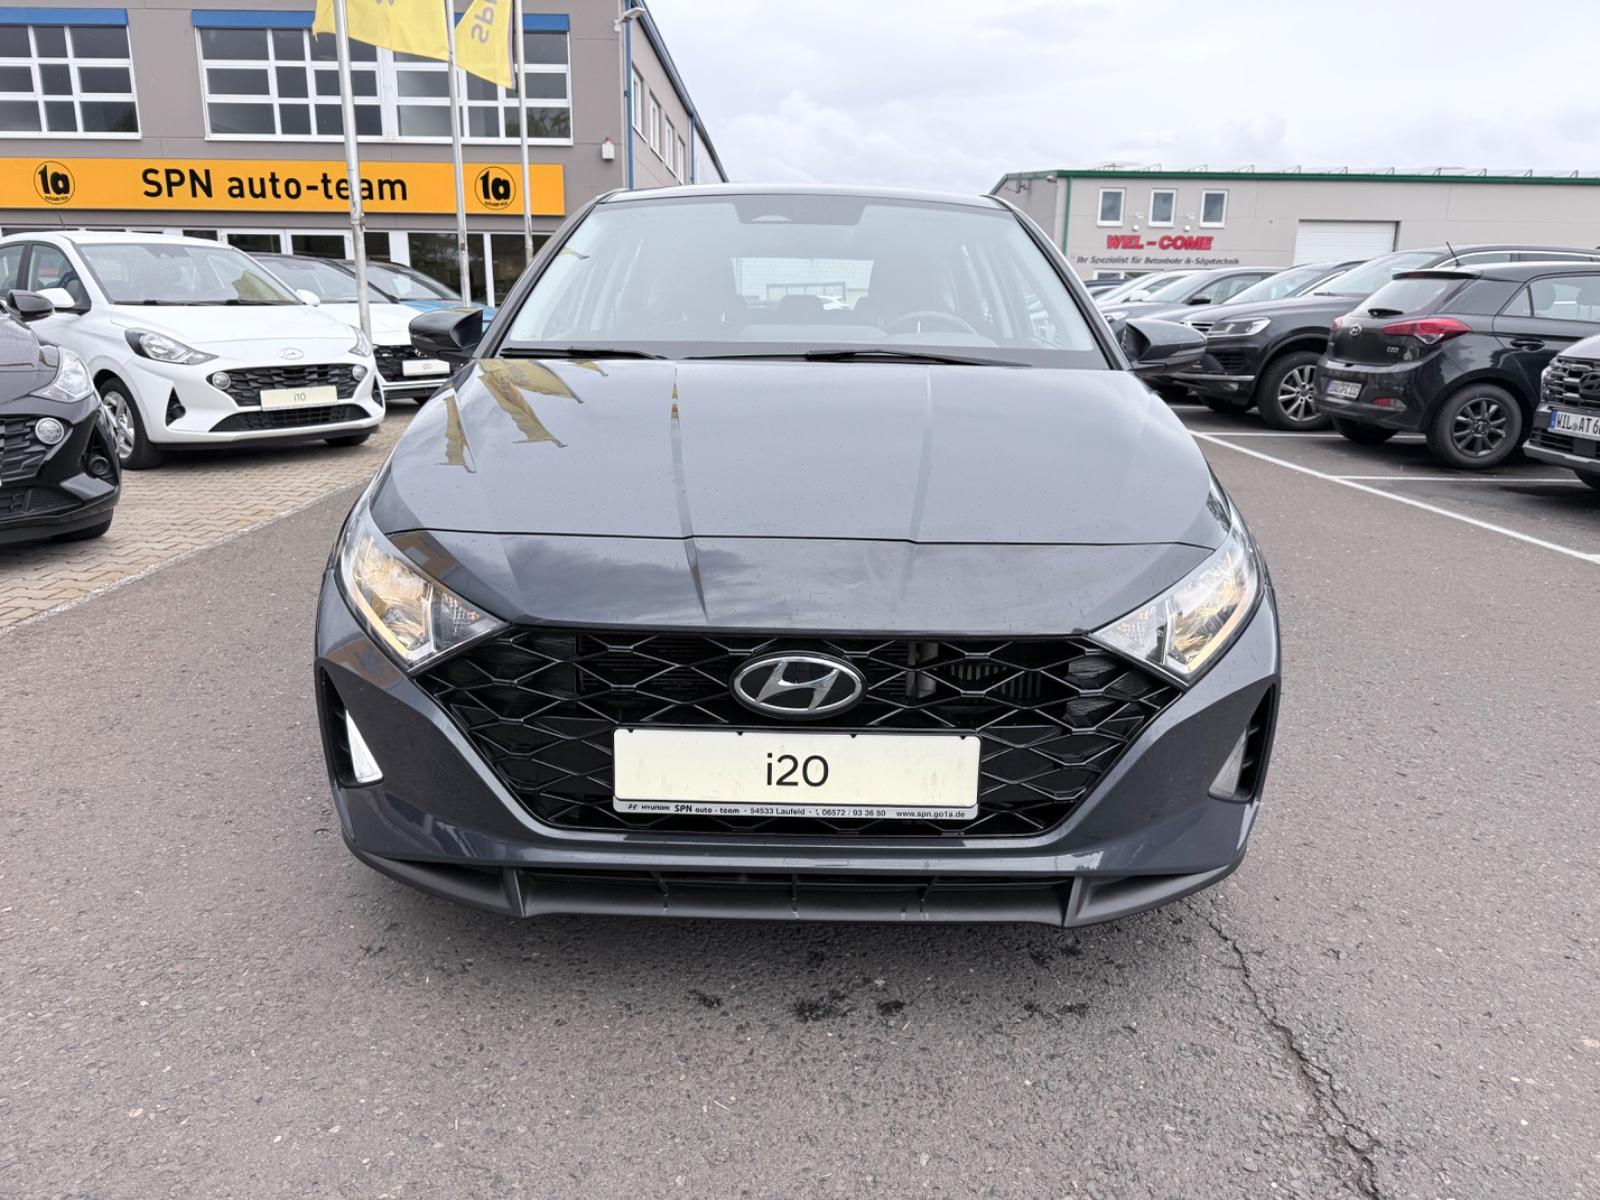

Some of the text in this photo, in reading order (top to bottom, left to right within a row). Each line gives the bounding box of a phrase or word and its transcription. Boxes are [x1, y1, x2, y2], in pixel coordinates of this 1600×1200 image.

[142, 168, 408, 200] SPN auto-team
[1077, 256, 1089, 264] Ihr
[1090, 256, 1129, 265] Spezialist
[1131, 256, 1143, 264] für
[767, 753, 829, 787] i20
[674, 804, 693, 812] SPN
[776, 808, 805, 816] Laufeld
[896, 810, 966, 819] www.spn.go1a.de
